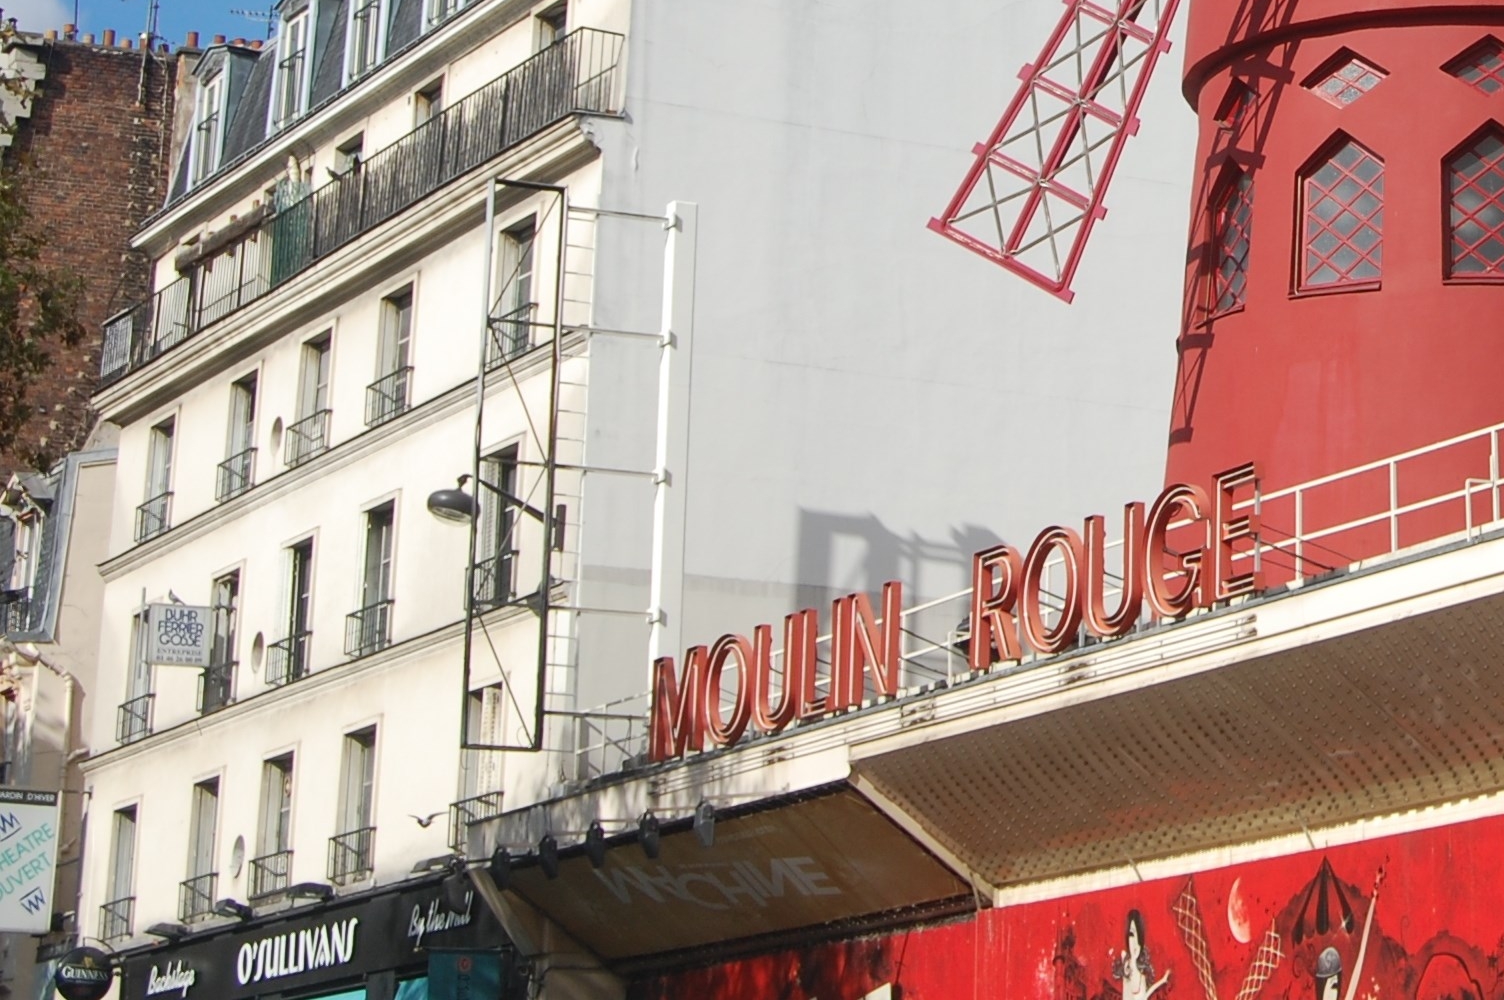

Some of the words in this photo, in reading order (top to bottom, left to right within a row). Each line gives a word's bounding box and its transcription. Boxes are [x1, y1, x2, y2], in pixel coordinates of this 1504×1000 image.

[158, 620, 204, 638] FERRIER
[648, 580, 902, 763] MOULIN
[969, 460, 1266, 671] ROUGE
[159, 632, 201, 648] GOSSE
[0, 851, 52, 901] UVERT
[426, 898, 446, 933] the
[237, 917, 358, 985] O'SULLIVANS
